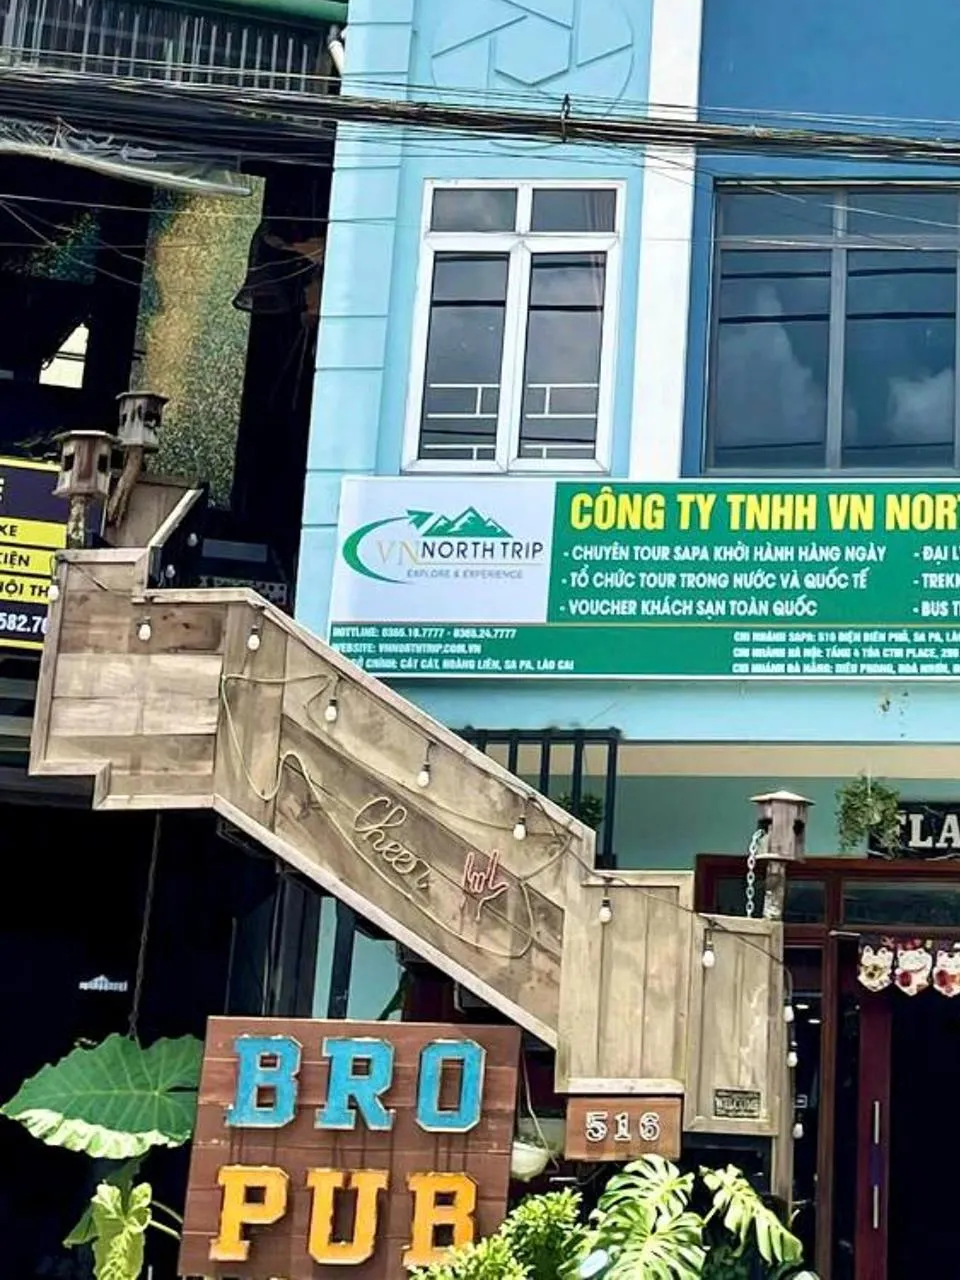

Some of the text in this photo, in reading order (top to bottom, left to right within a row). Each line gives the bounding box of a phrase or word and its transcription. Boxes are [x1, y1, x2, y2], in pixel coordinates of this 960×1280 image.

[570, 486, 665, 530] CÔNG
[676, 493, 717, 530] TY
[727, 493, 816, 530] TNHH
[828, 493, 876, 530] VN
[0, 551, 30, 568] IỆN
[421, 541, 495, 560] NORTH
[500, 541, 544, 559] TRIP
[571, 543, 629, 561] CHUYÊN
[633, 545, 671, 561] TOUR
[673, 545, 710, 561] SAPA
[753, 542, 794, 561] HÀNH
[799, 542, 842, 561] HÀNG
[844, 542, 886, 561] NGÀY
[922, 545, 949, 565] ĐẠI
[0, 579, 24, 597] ỘI
[593, 568, 635, 588] CHỨC
[639, 573, 676, 588] TOUR
[680, 573, 729, 588] TRONG
[780, 569, 801, 588] VÀ
[804, 566, 849, 589] QUỐC
[569, 592, 818, 620] VOUCHER KHÁCH SẠN TOÀN QUỐC
[921, 600, 949, 617] BUS
[225, 1034, 488, 1134] BRO
[585, 1111, 661, 1142] 516
[208, 1164, 481, 1267] PUB
